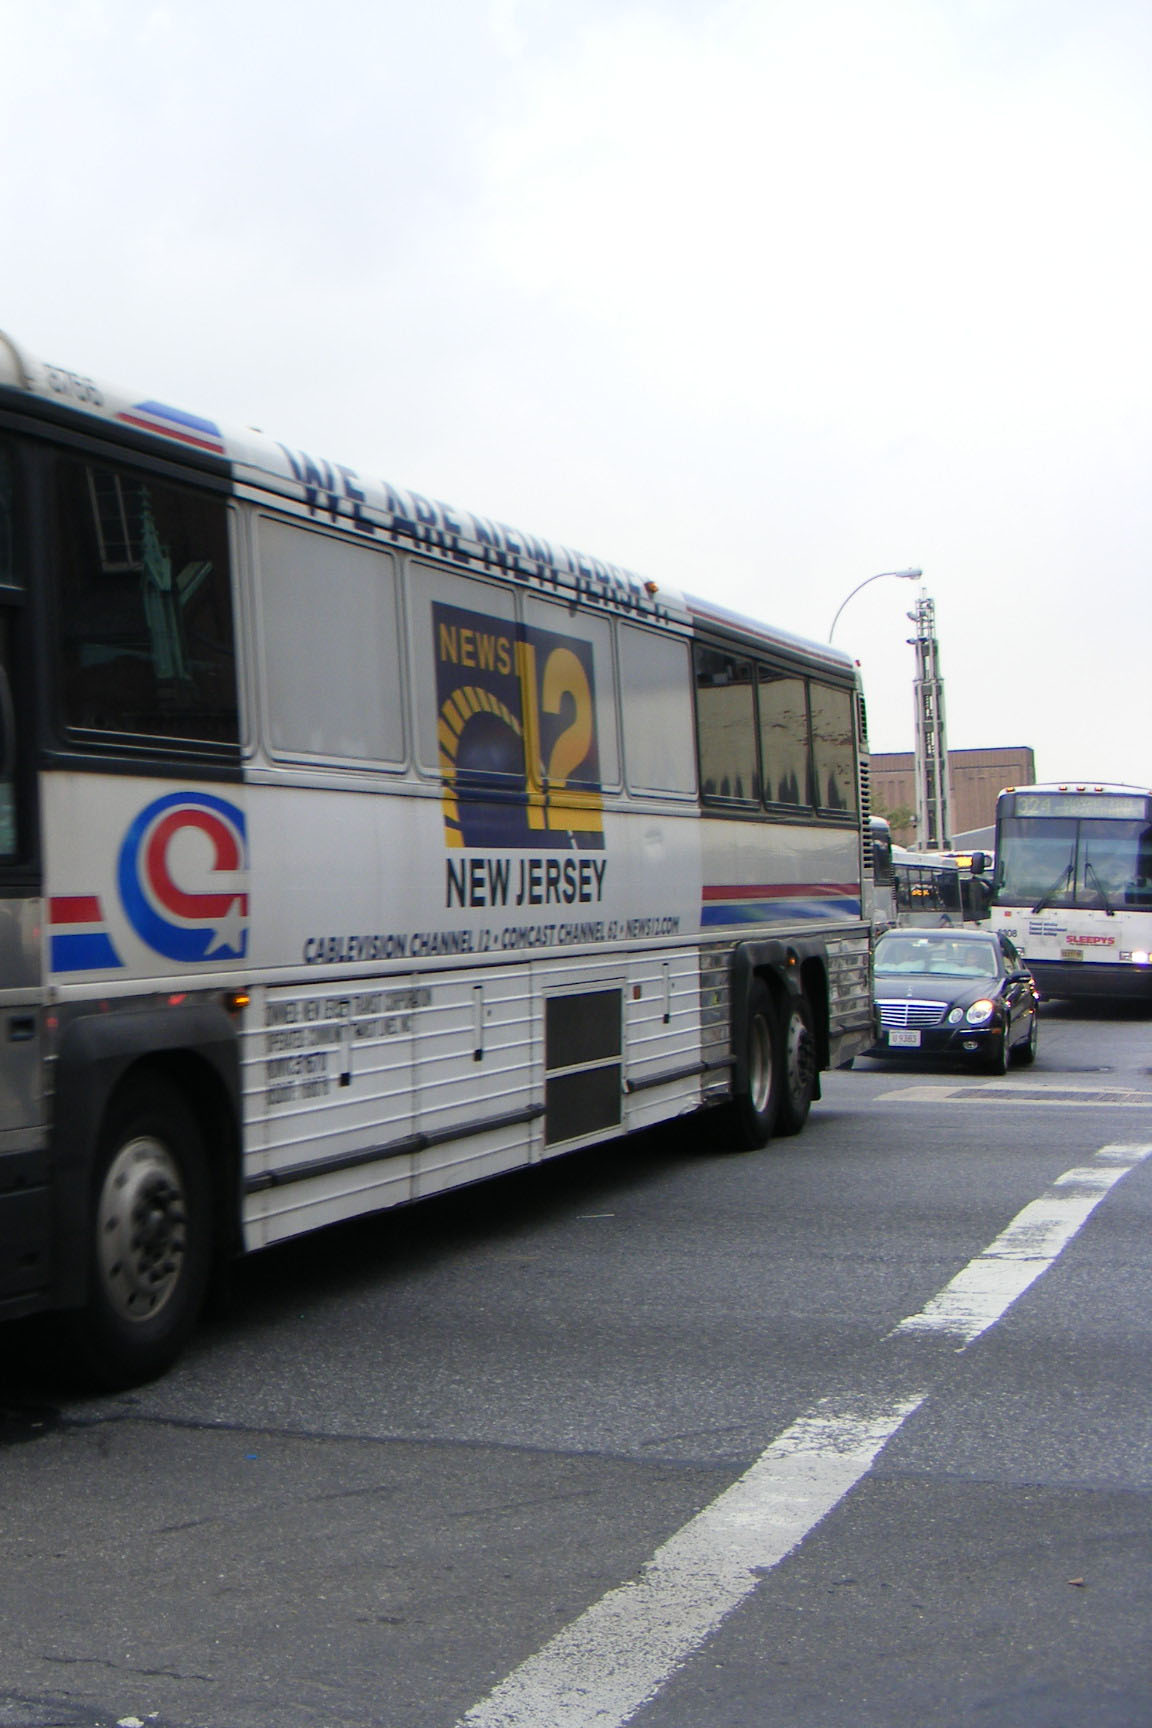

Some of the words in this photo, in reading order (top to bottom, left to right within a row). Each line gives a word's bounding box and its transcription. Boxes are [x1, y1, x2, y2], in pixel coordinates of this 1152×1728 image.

[274, 441, 375, 536] WE
[381, 479, 470, 565] ARE
[464, 510, 559, 592] NEW
[439, 622, 512, 679] NEWS
[513, 640, 604, 833] 12
[445, 857, 512, 909] NEW
[515, 857, 608, 907] JERSEY
[304, 934, 407, 964] CABLEVISION
[410, 929, 473, 957] CHANNEL
[478, 928, 492, 952] 12
[501, 924, 556, 949] COMCAST
[557, 920, 605, 944] CHANNEL
